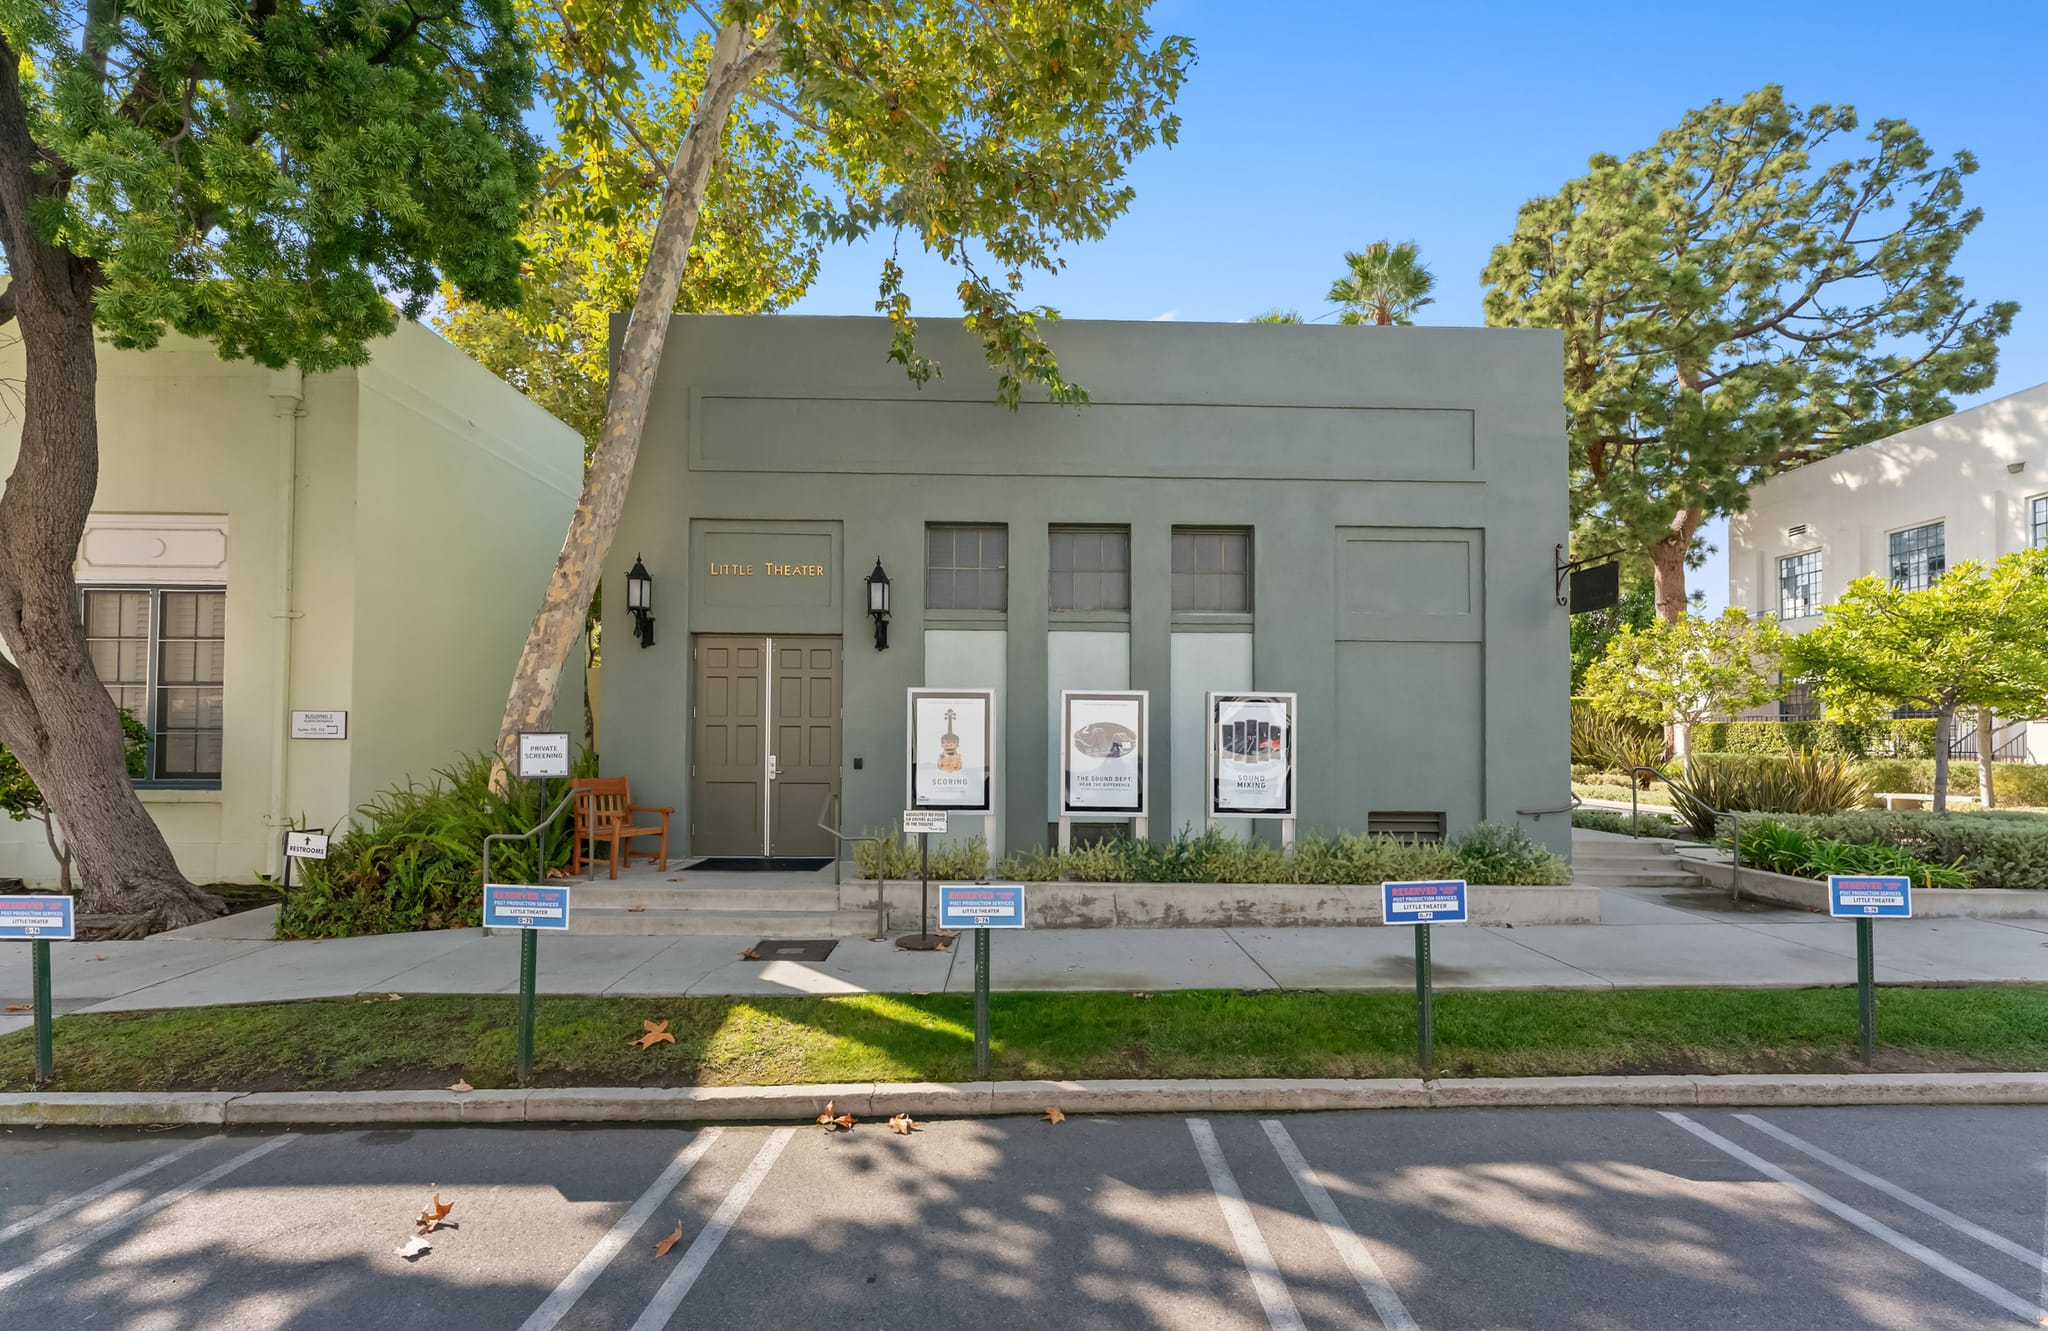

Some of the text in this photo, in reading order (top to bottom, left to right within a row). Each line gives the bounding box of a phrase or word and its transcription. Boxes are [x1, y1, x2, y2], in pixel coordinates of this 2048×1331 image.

[710, 562, 824, 576] LITTLE THEATER
[290, 846, 324, 854] RESTROOMS
[493, 891, 539, 900] RESERVED
[1392, 887, 1437, 896] RESERVED
